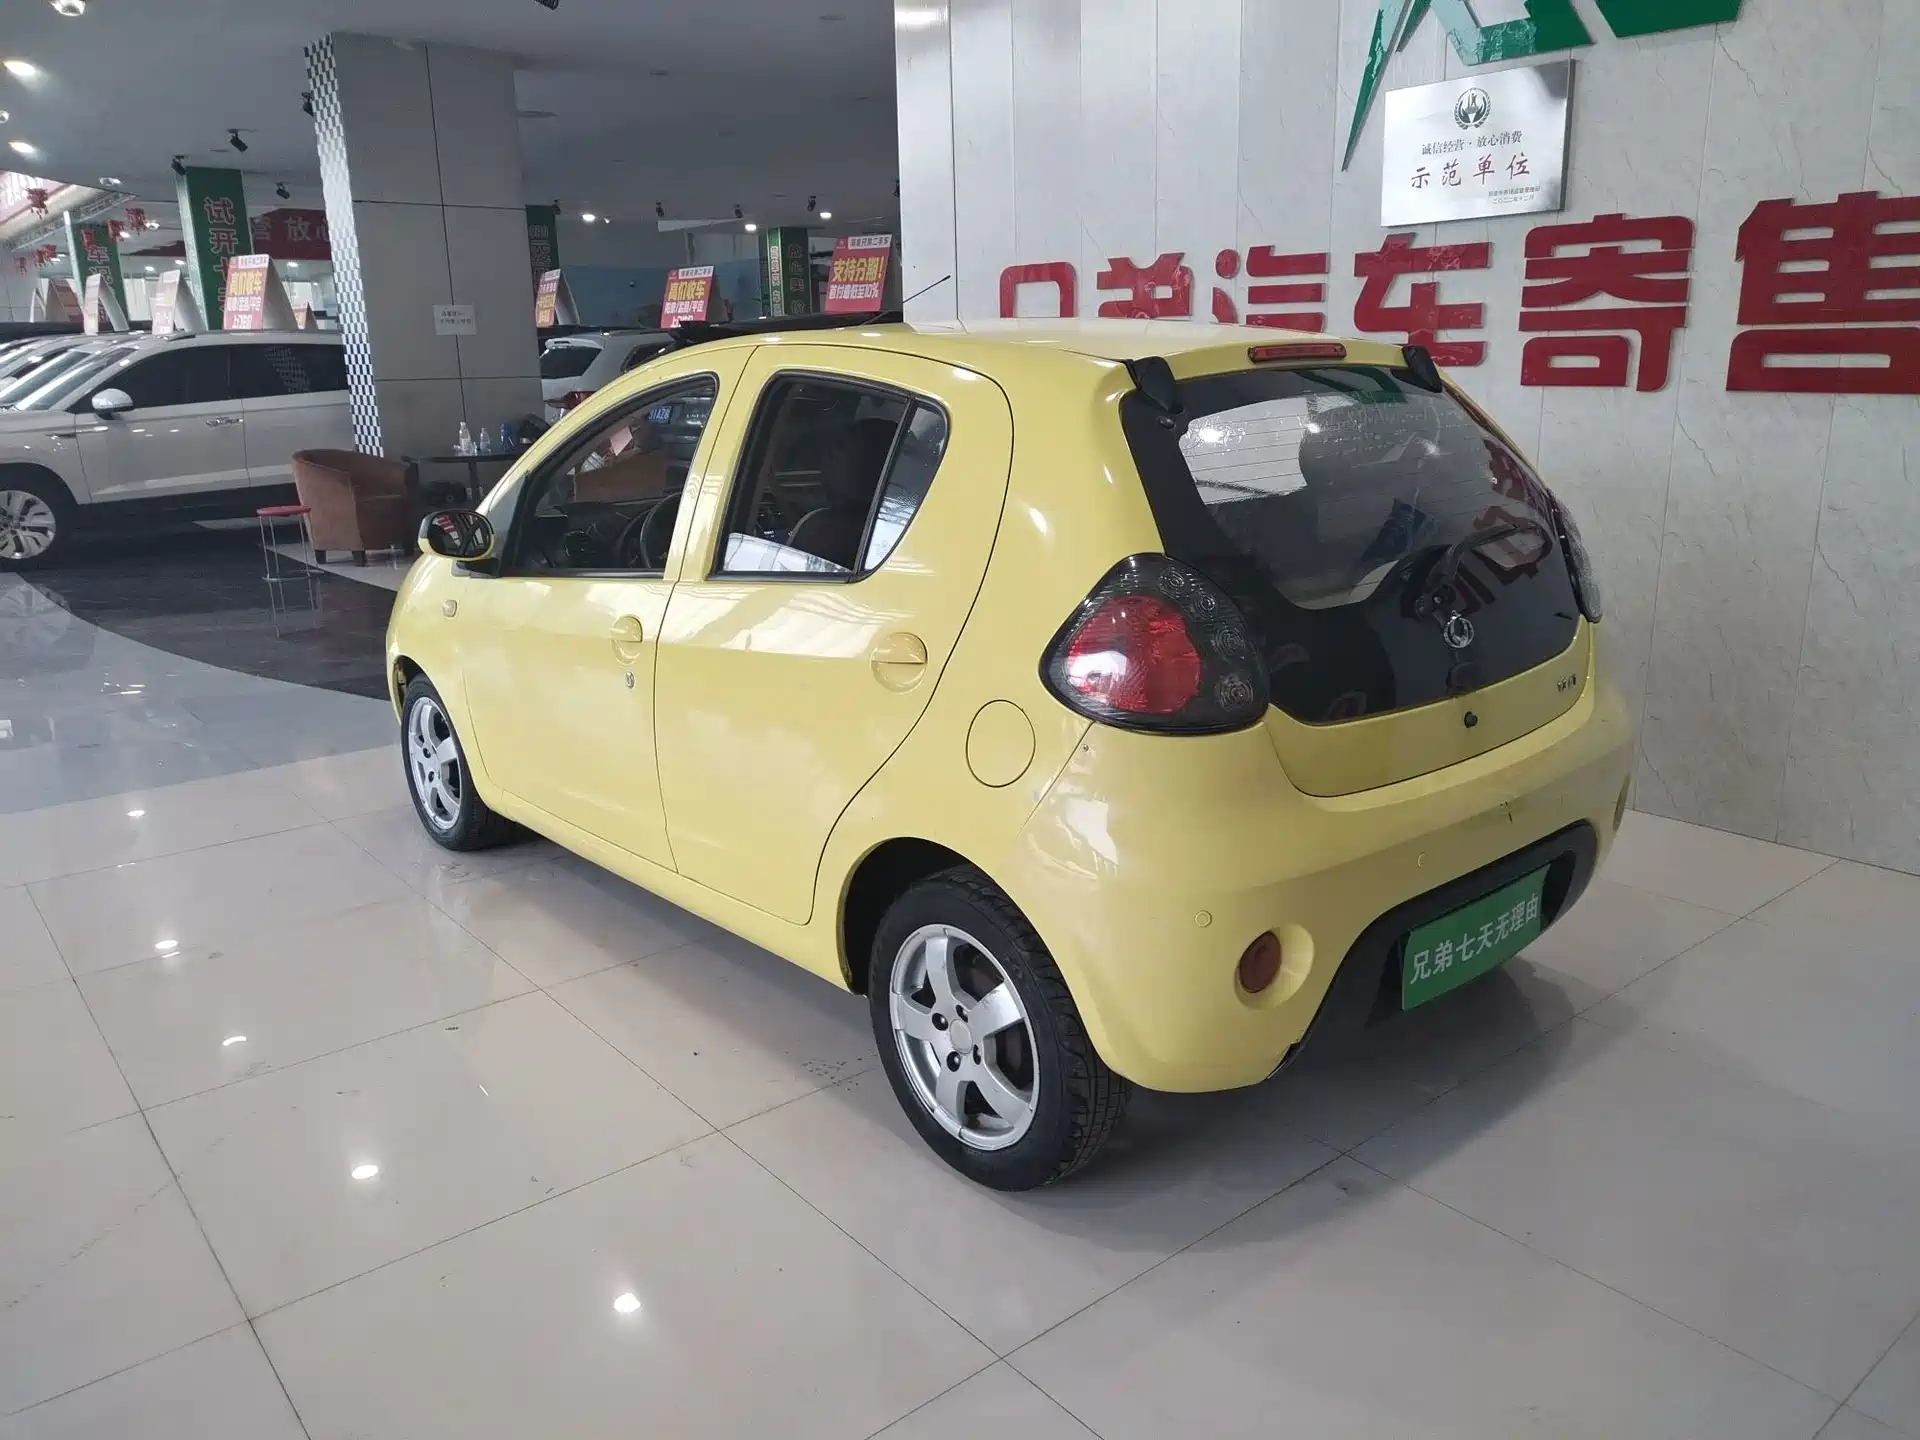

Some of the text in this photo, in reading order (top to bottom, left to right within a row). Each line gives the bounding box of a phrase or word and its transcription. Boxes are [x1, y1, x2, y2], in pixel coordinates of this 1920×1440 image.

[1421, 130, 1522, 155] 诚信经营·放心消费
[1411, 152, 1531, 188] 示范单位
[832, 256, 885, 282] 支持分期!
[668, 280, 706, 301] 高价收车
[1410, 892, 1539, 985] 兄弟七天无理由
